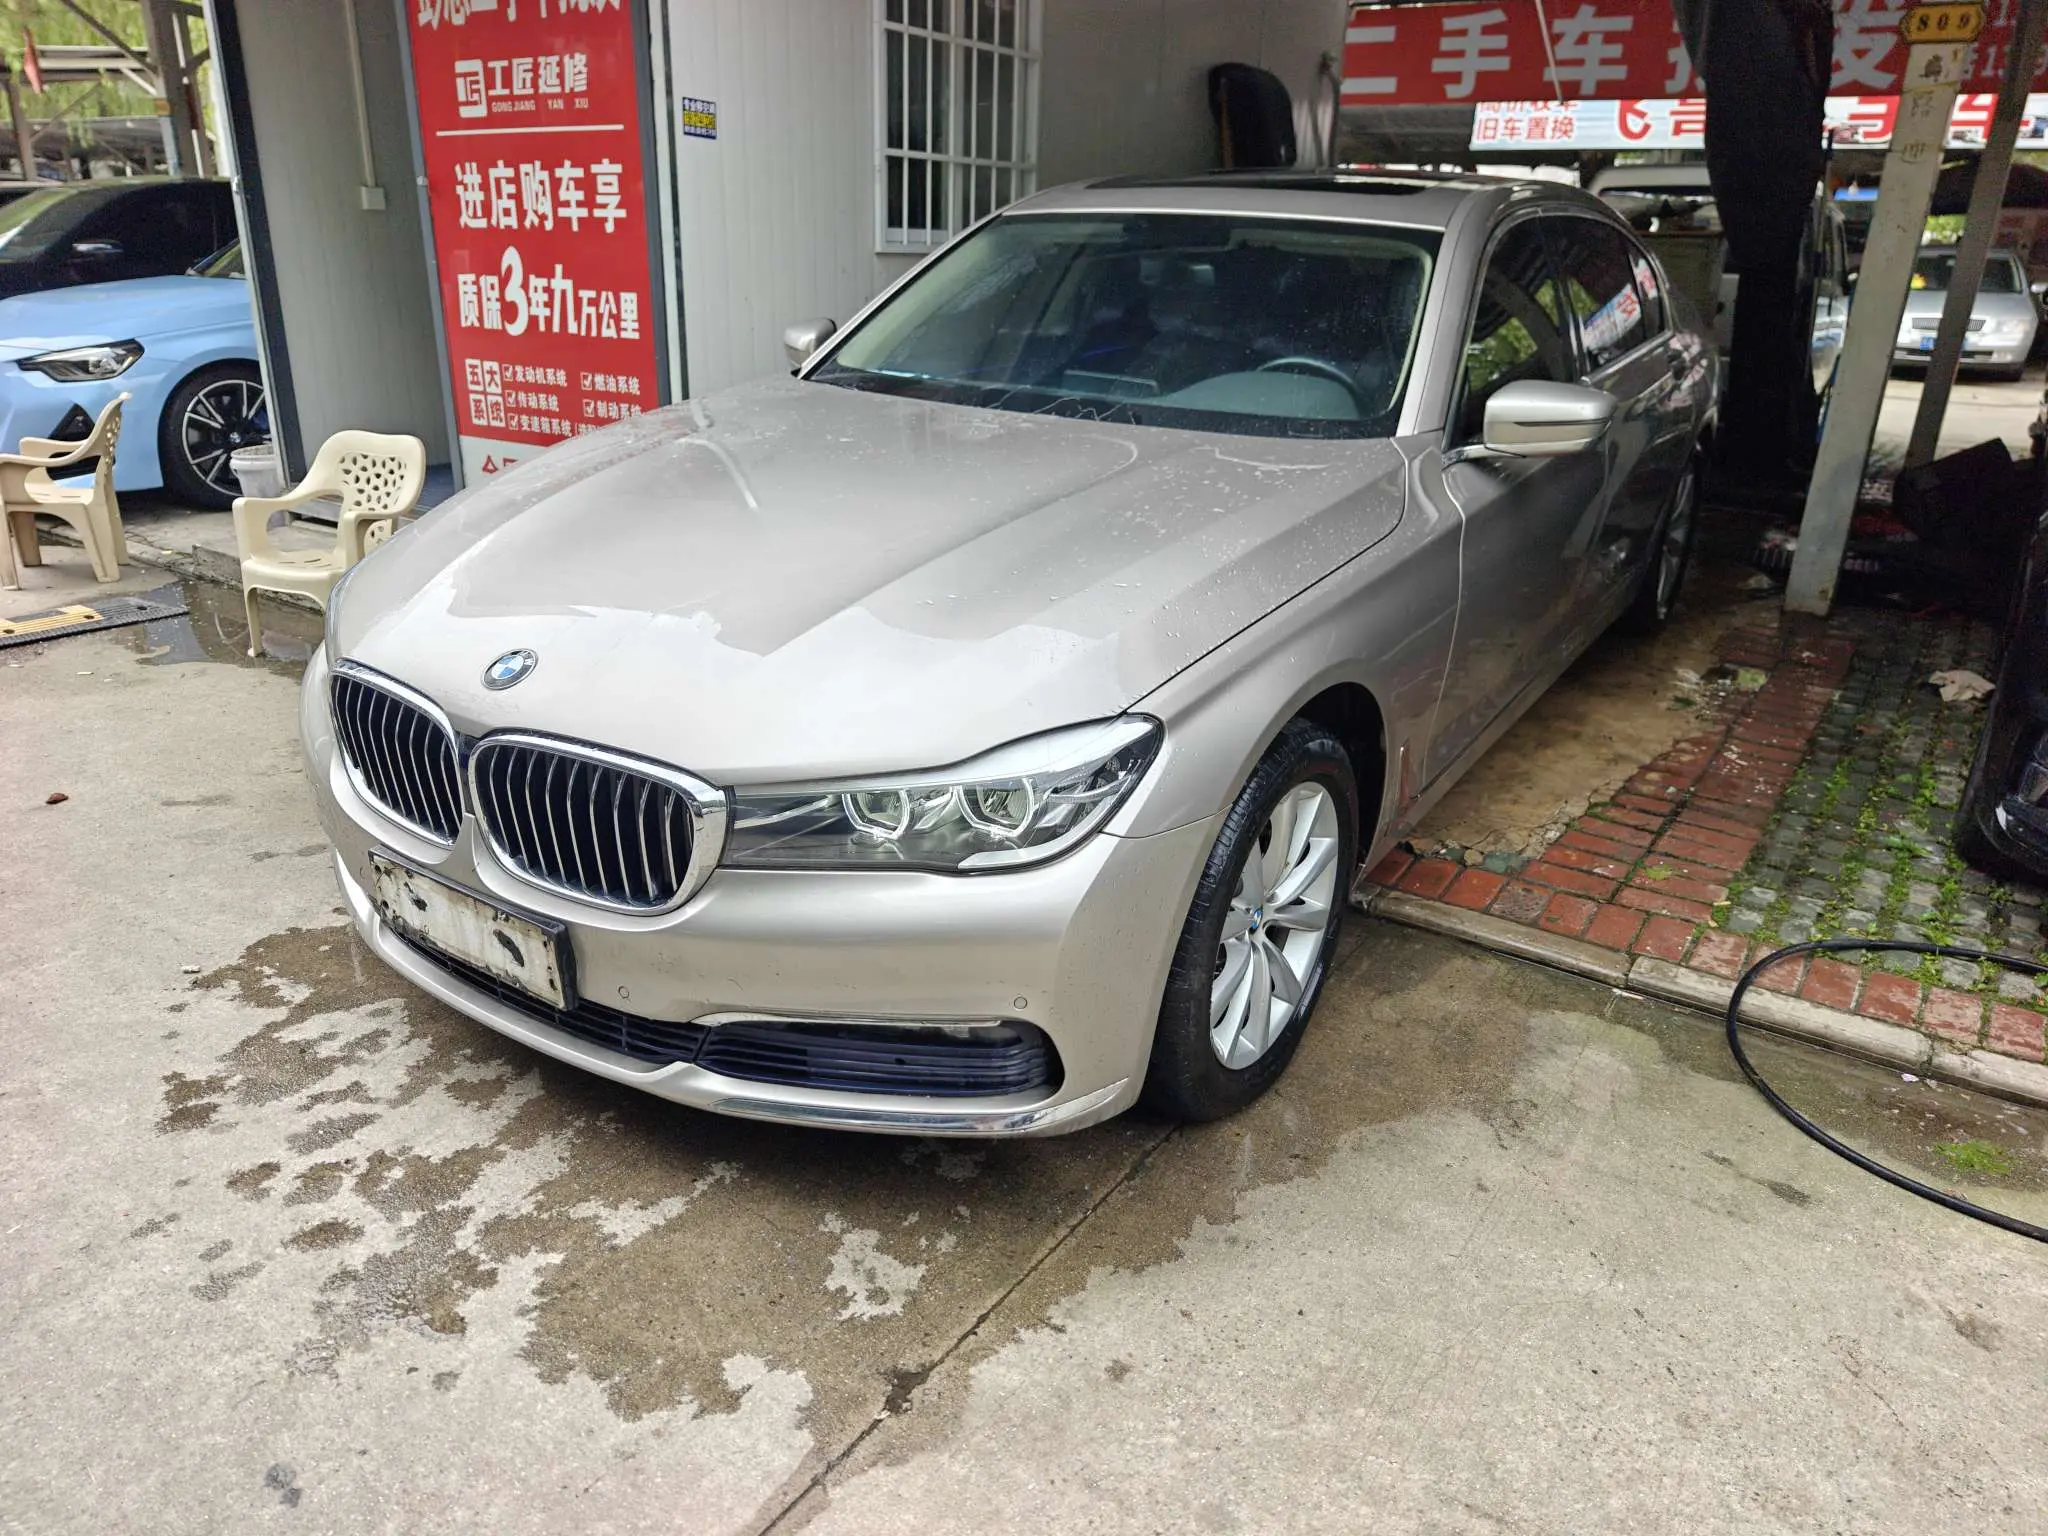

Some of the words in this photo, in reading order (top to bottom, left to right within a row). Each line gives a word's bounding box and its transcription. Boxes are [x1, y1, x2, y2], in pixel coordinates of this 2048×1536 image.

[487, 52, 588, 96] 工匠延修
[547, 98, 564, 110] YAN
[574, 97, 589, 109] XIU
[1475, 116, 1576, 142] 旧车置换
[454, 158, 627, 234] 进店购车享
[457, 245, 640, 340] 质保3年九万公里
[514, 365, 568, 388] 发动机系统
[518, 391, 560, 413] 传动系统
